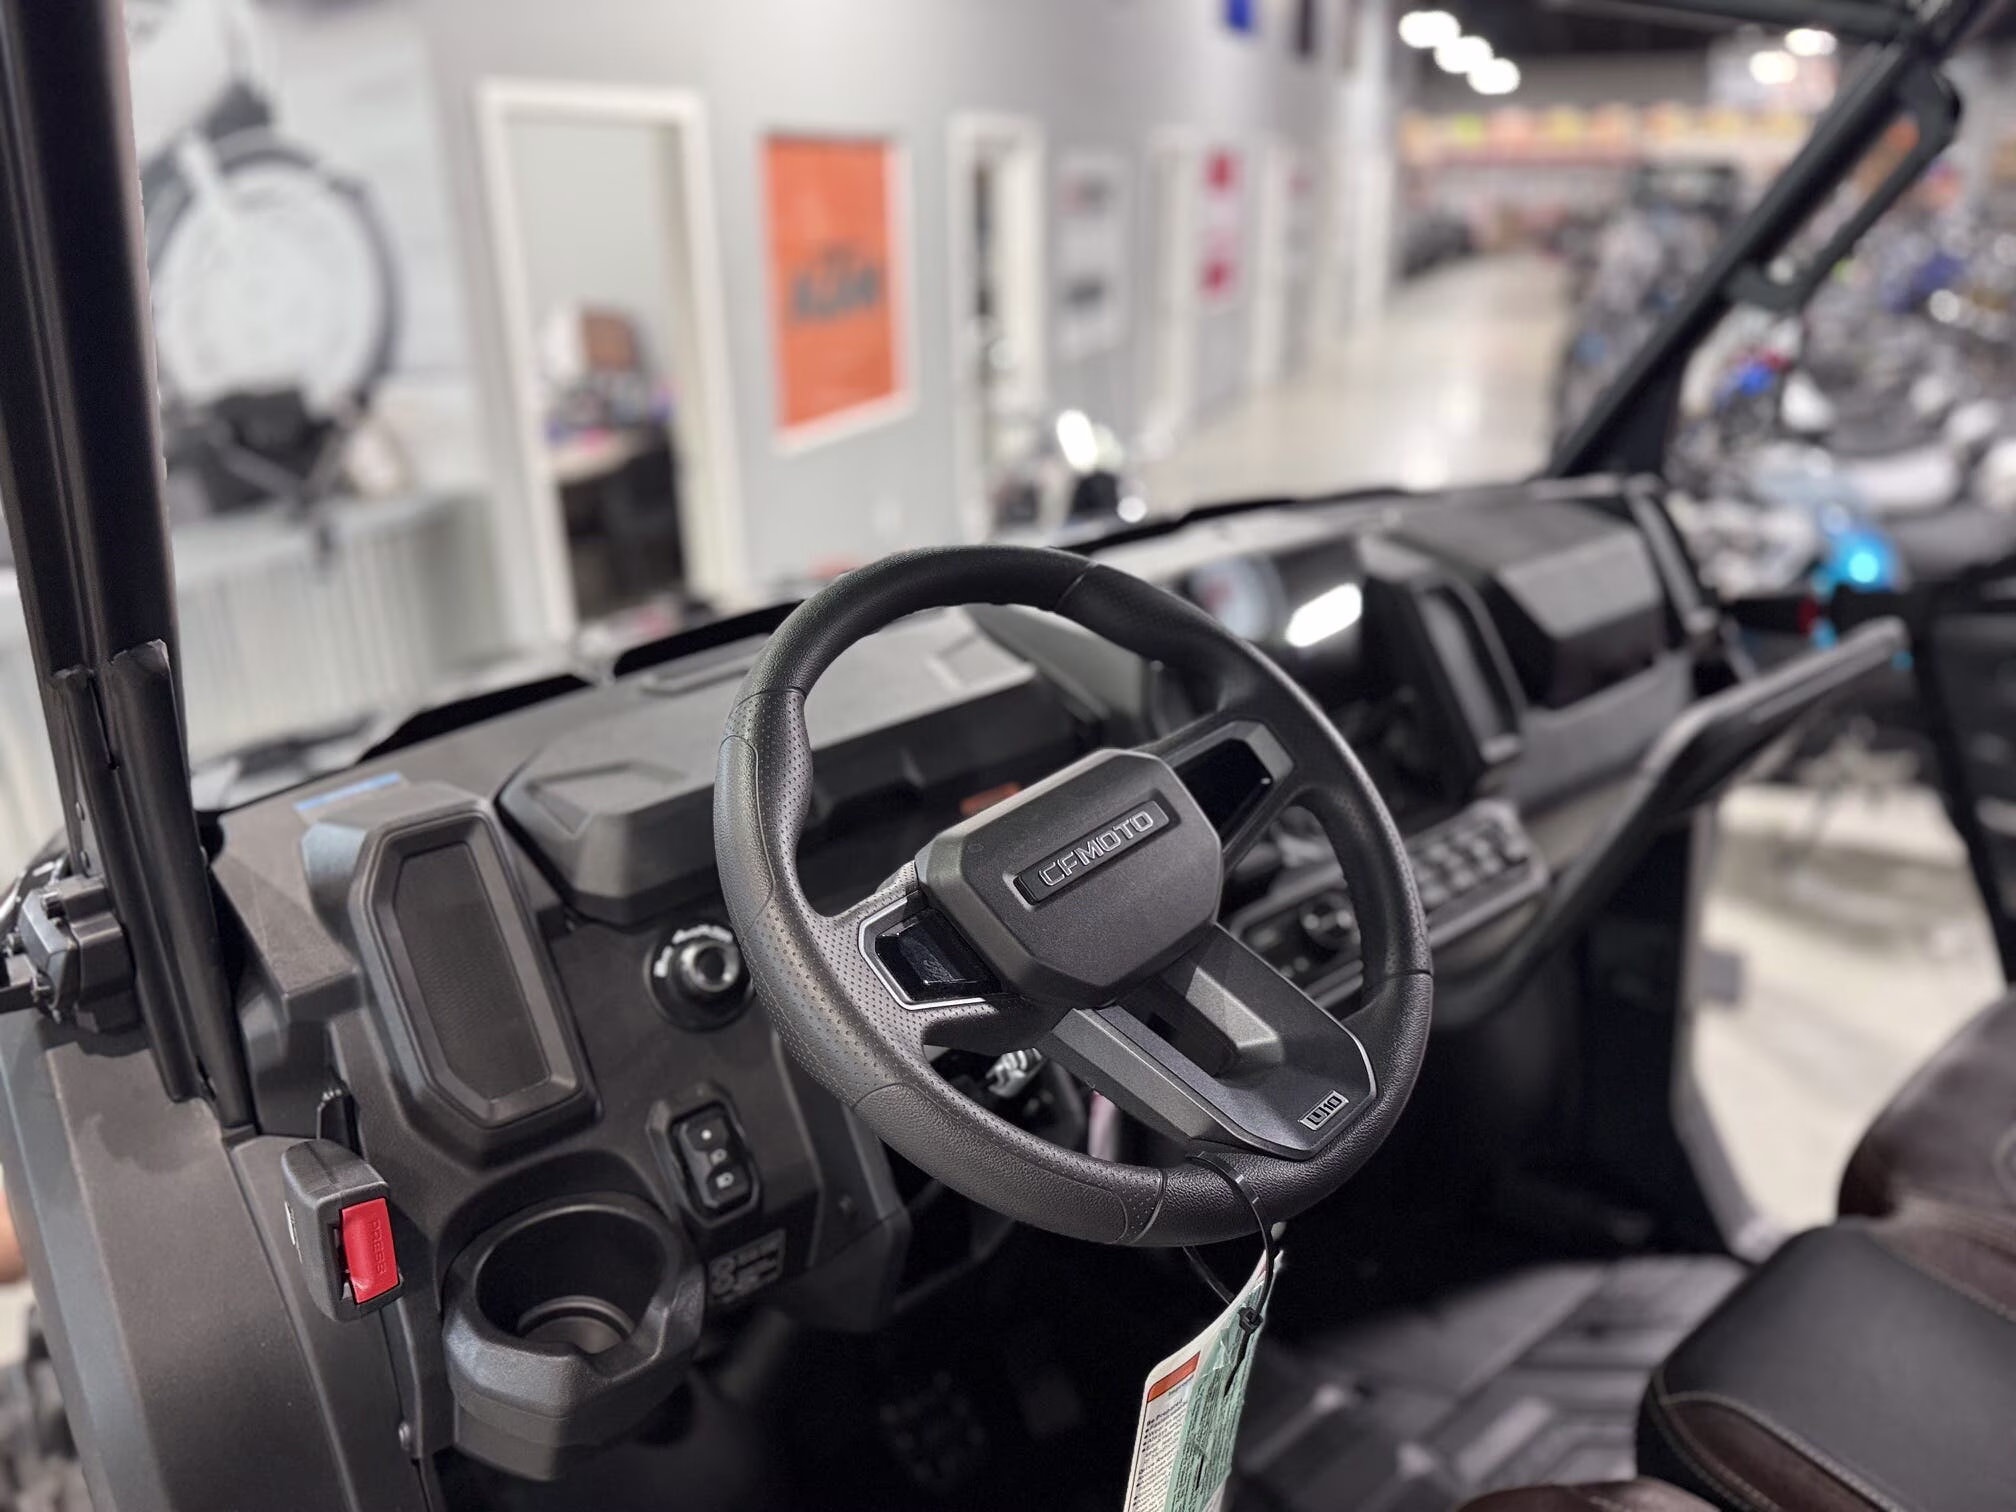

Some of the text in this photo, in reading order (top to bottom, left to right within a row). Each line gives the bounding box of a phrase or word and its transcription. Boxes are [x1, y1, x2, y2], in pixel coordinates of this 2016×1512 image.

[1038, 810, 1154, 886] CFMOTO
[1306, 1095, 1343, 1126] U10
[368, 1217, 387, 1275] PRESS
